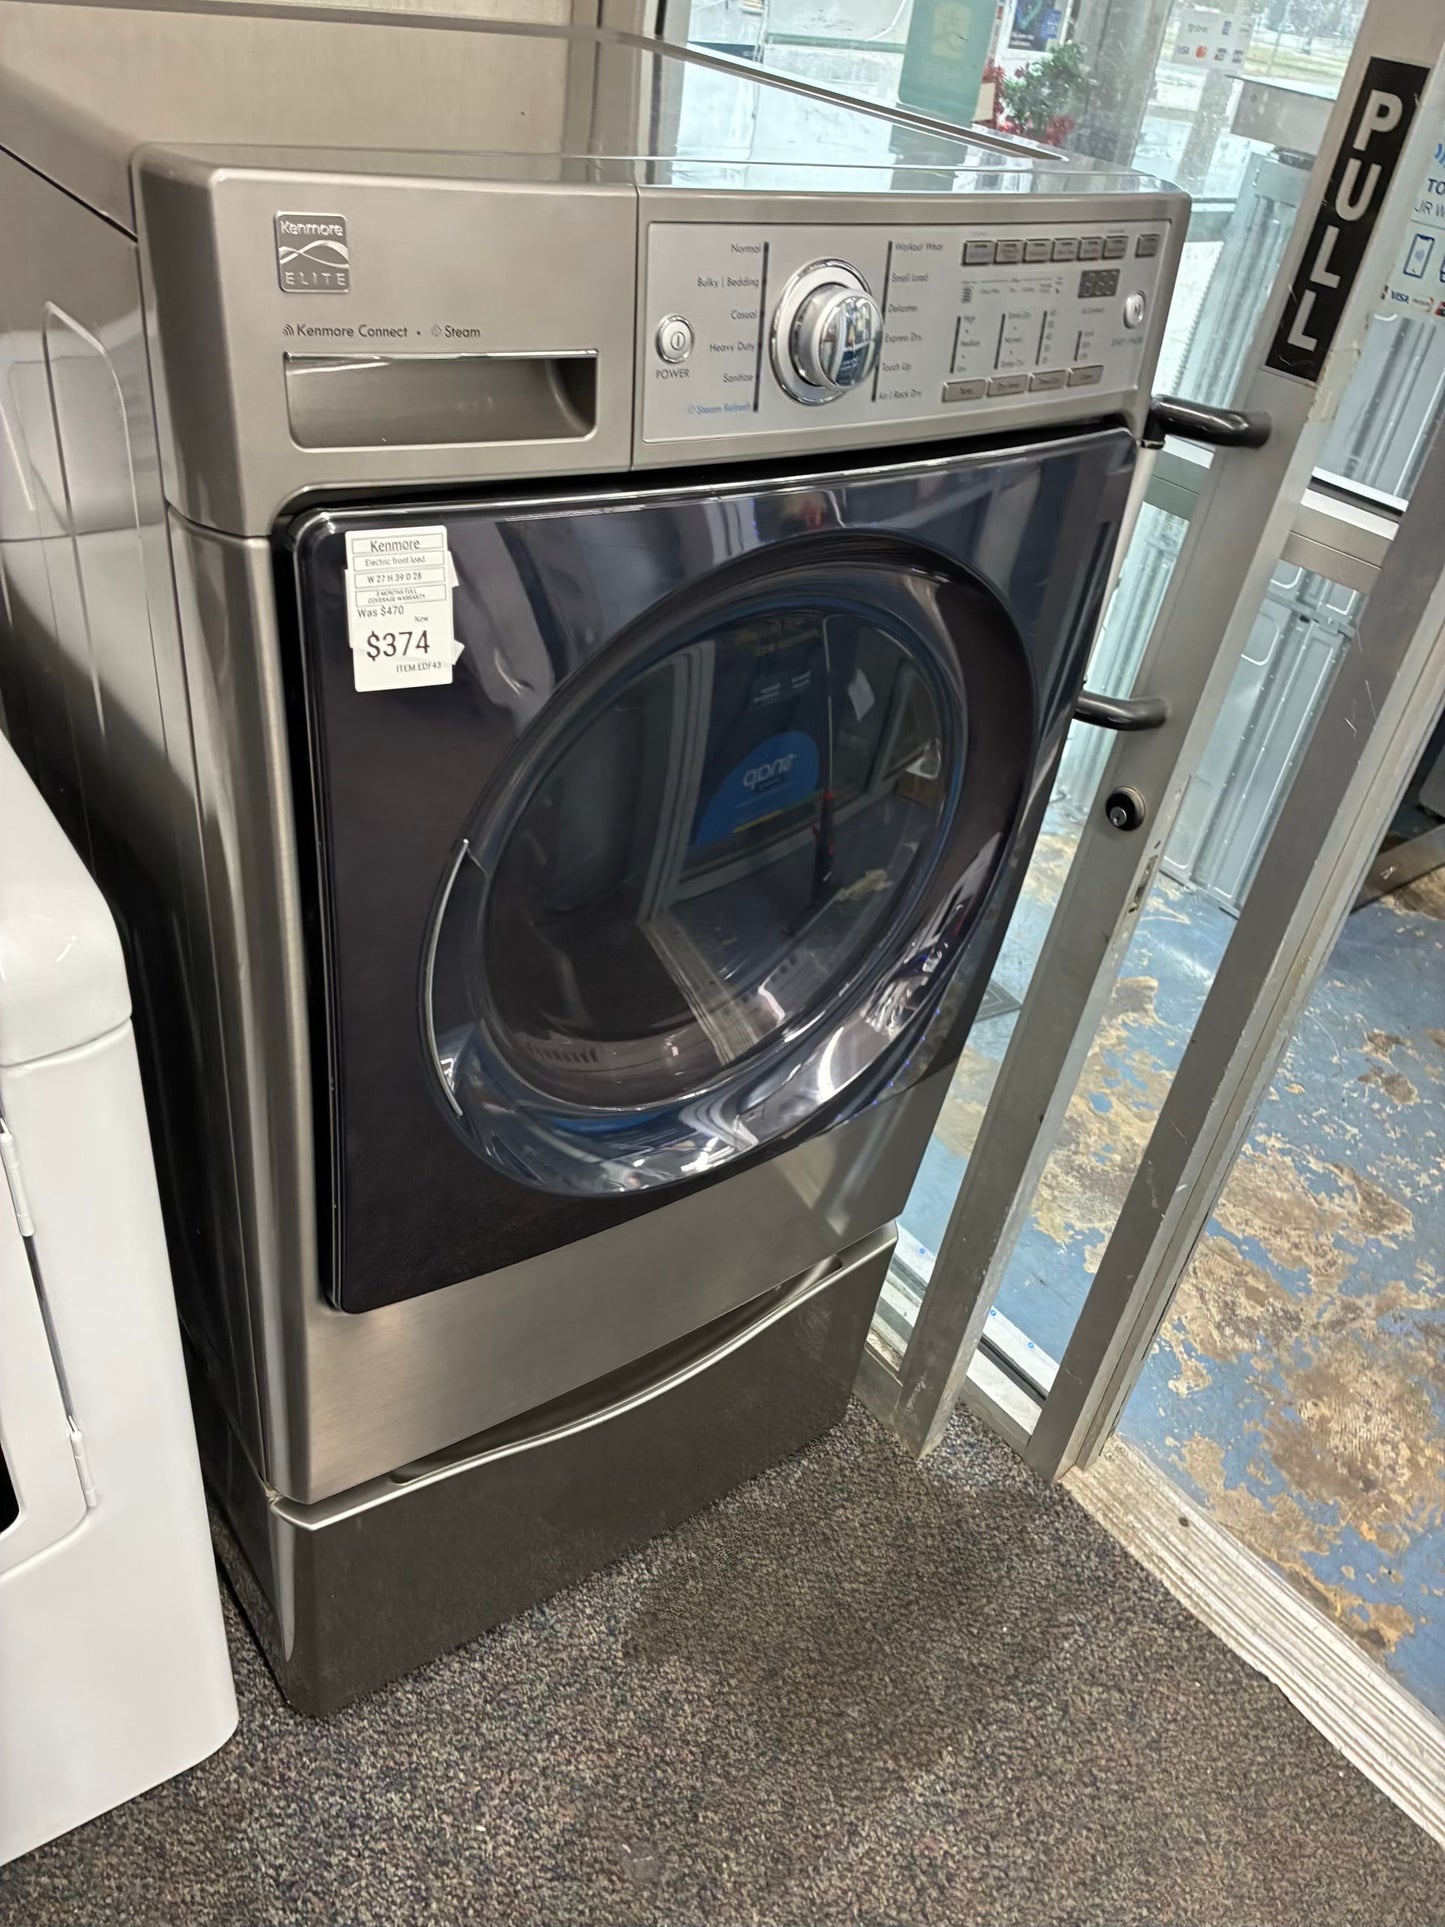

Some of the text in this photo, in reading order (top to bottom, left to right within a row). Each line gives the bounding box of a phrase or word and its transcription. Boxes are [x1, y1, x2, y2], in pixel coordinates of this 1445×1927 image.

[1286, 89, 1403, 352] PULL
[280, 220, 344, 236] Kenmore
[730, 243, 761, 254] Normal
[285, 271, 346, 286] ELITE
[697, 276, 718, 289] Bulky
[727, 276, 760, 288] Bedding
[730, 309, 758, 320] Casual
[296, 324, 481, 338] Kenmore Connect Steam
[709, 341, 755, 353] Heavy Duty
[655, 368, 690, 380] POWER
[370, 539, 421, 553] Kenmore
[365, 555, 426, 567] Electric front load
[367, 575, 375, 583] W
[376, 574, 386, 583] 27
[387, 574, 393, 582] H
[395, 573, 404, 582] 39
[357, 604, 405, 618] Was $470
[414, 615, 429, 623] Now
[366, 630, 430, 661] $374
